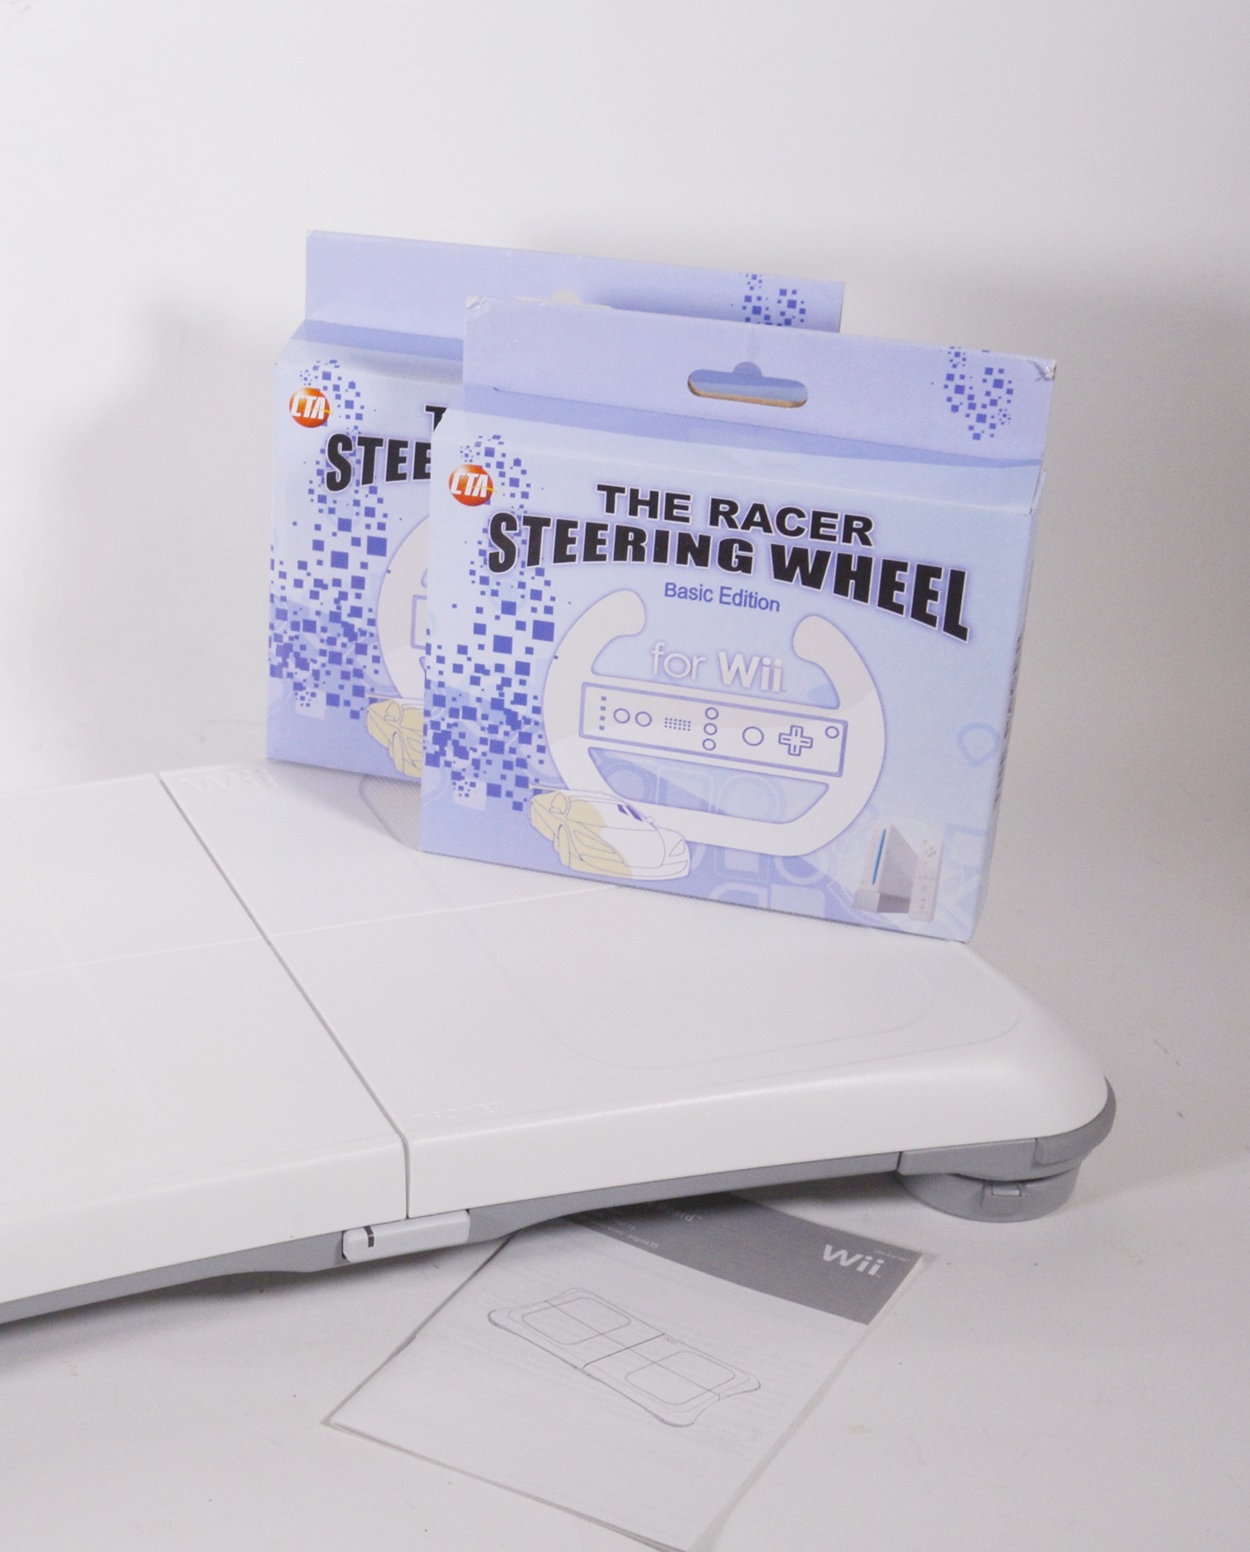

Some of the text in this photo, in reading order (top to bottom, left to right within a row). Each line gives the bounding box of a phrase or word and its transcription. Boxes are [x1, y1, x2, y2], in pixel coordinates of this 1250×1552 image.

[290, 394, 326, 420] CTA
[450, 471, 489, 499] CTA
[597, 484, 874, 547] THE RACER
[488, 511, 969, 643] STEERING WHEEL
[664, 582, 781, 612] Basic Edition
[652, 642, 784, 693] for Wii
[823, 1244, 885, 1276] Wii
